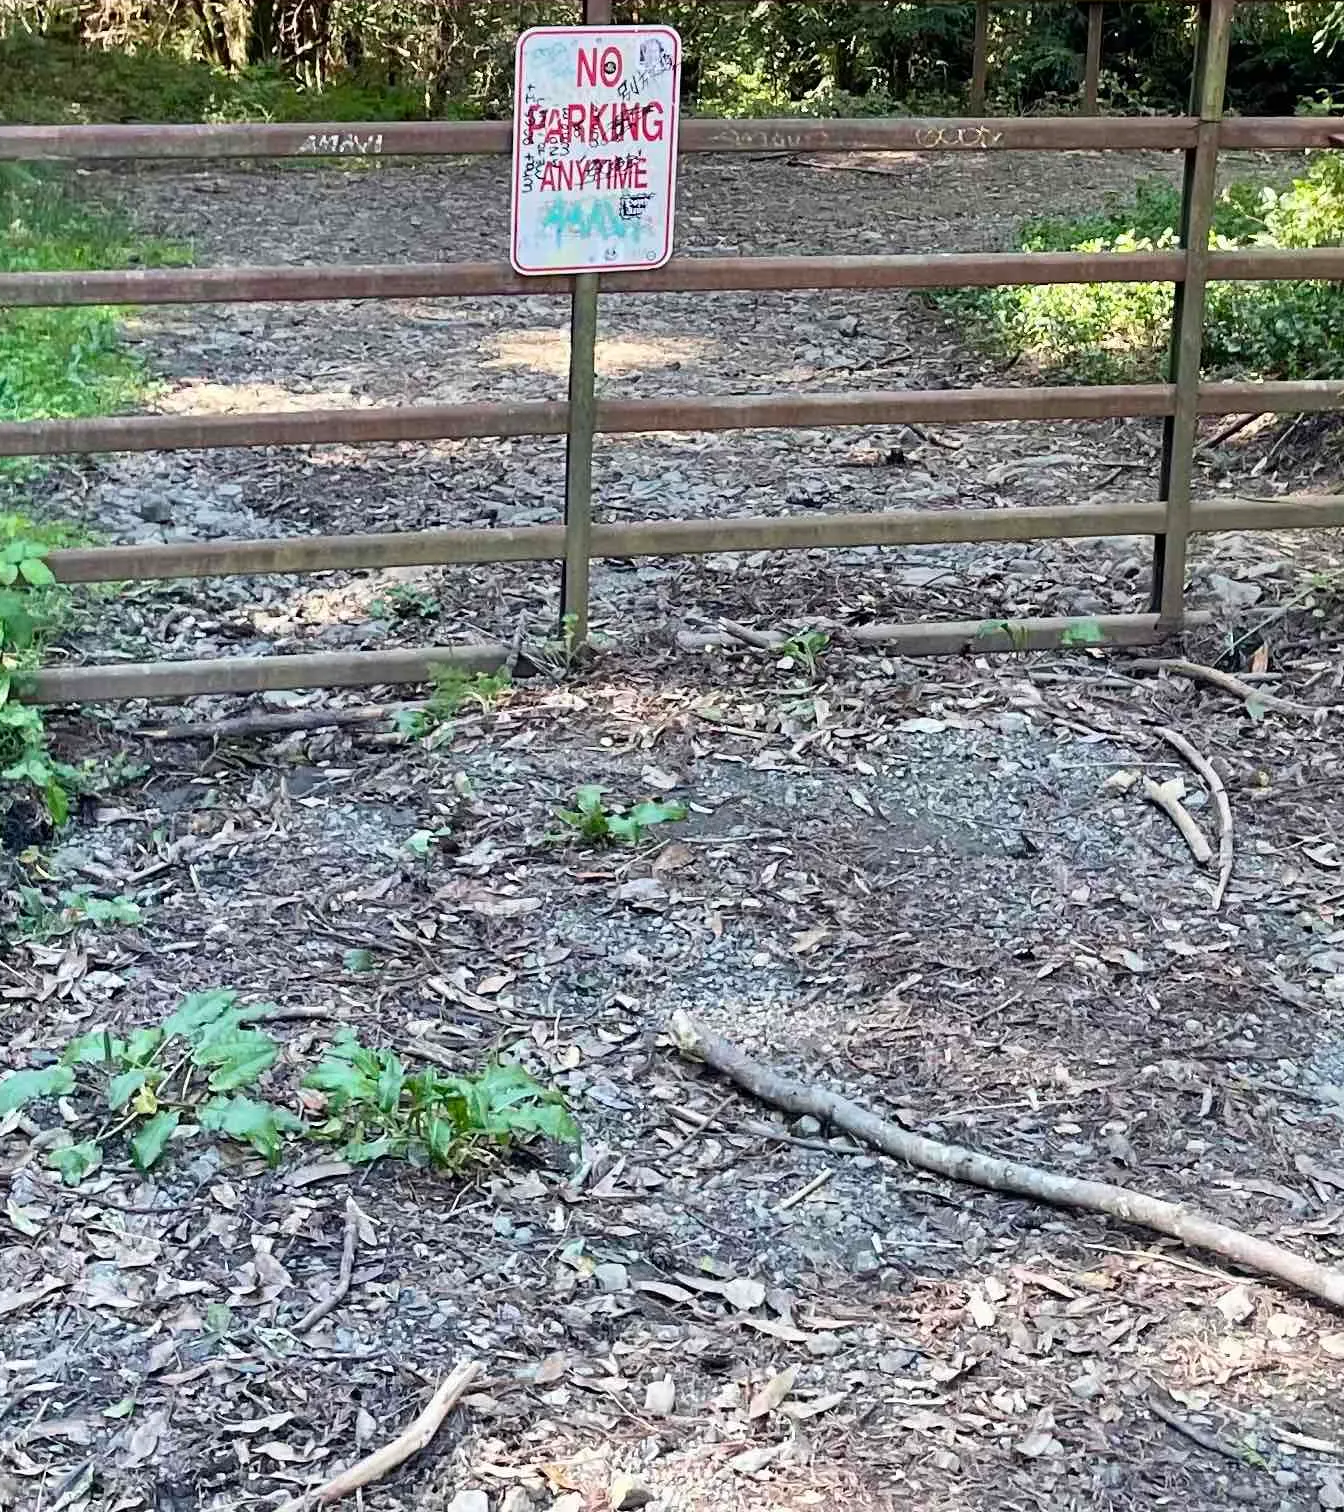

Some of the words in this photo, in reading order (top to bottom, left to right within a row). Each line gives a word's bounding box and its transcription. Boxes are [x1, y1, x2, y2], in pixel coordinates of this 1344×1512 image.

[576, 46, 623, 88] NO
[527, 102, 664, 145] PARKING
[540, 156, 648, 192] ANYTIME
